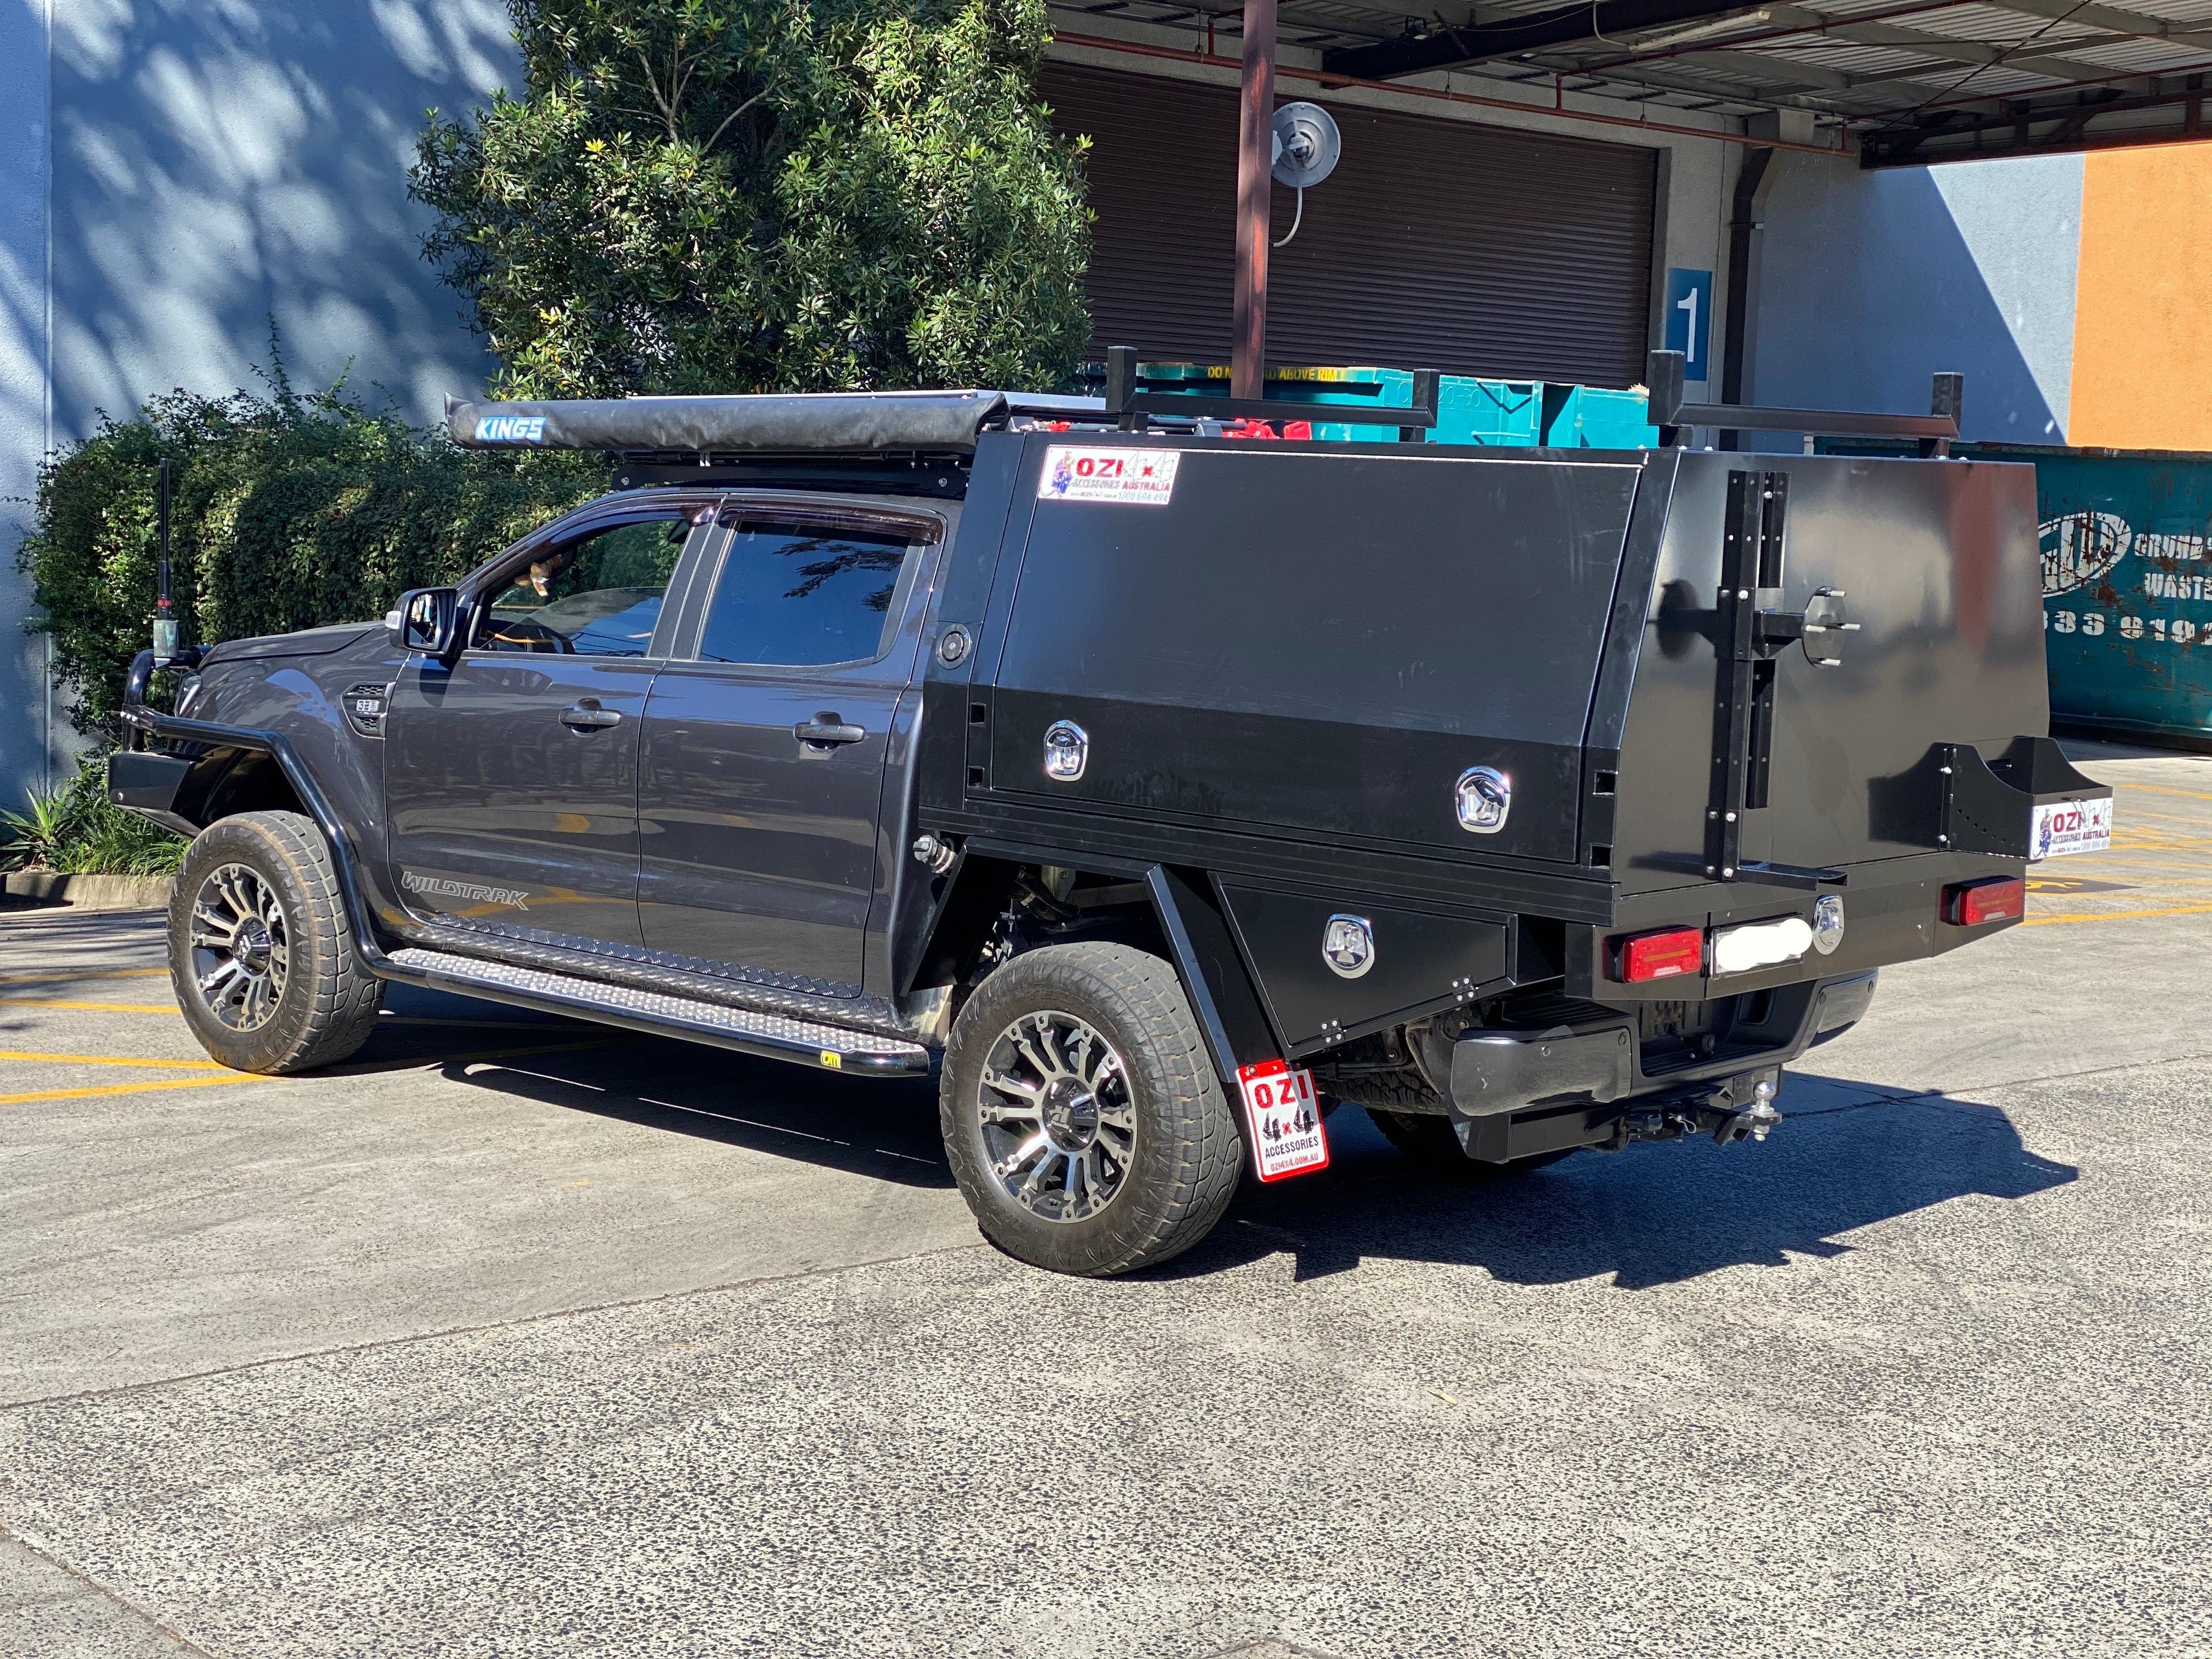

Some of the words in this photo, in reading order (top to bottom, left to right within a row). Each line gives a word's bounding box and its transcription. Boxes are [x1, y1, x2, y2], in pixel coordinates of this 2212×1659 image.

[1677, 287, 1698, 363] 1
[1207, 366, 1223, 378] DO
[1279, 368, 1315, 380] ABOVE
[1318, 368, 1338, 381] RIM
[476, 419, 545, 440] KINGS
[1075, 457, 1124, 478] OZI
[1122, 481, 1170, 492] AUSTRALIA
[2053, 811, 2082, 833] OZI
[2082, 828, 2110, 841] AUSTRALIA
[401, 871, 530, 911] WILDTRAK
[1254, 1074, 1310, 1109] OZI
[1265, 1135, 1319, 1159] ACCESSORIES
